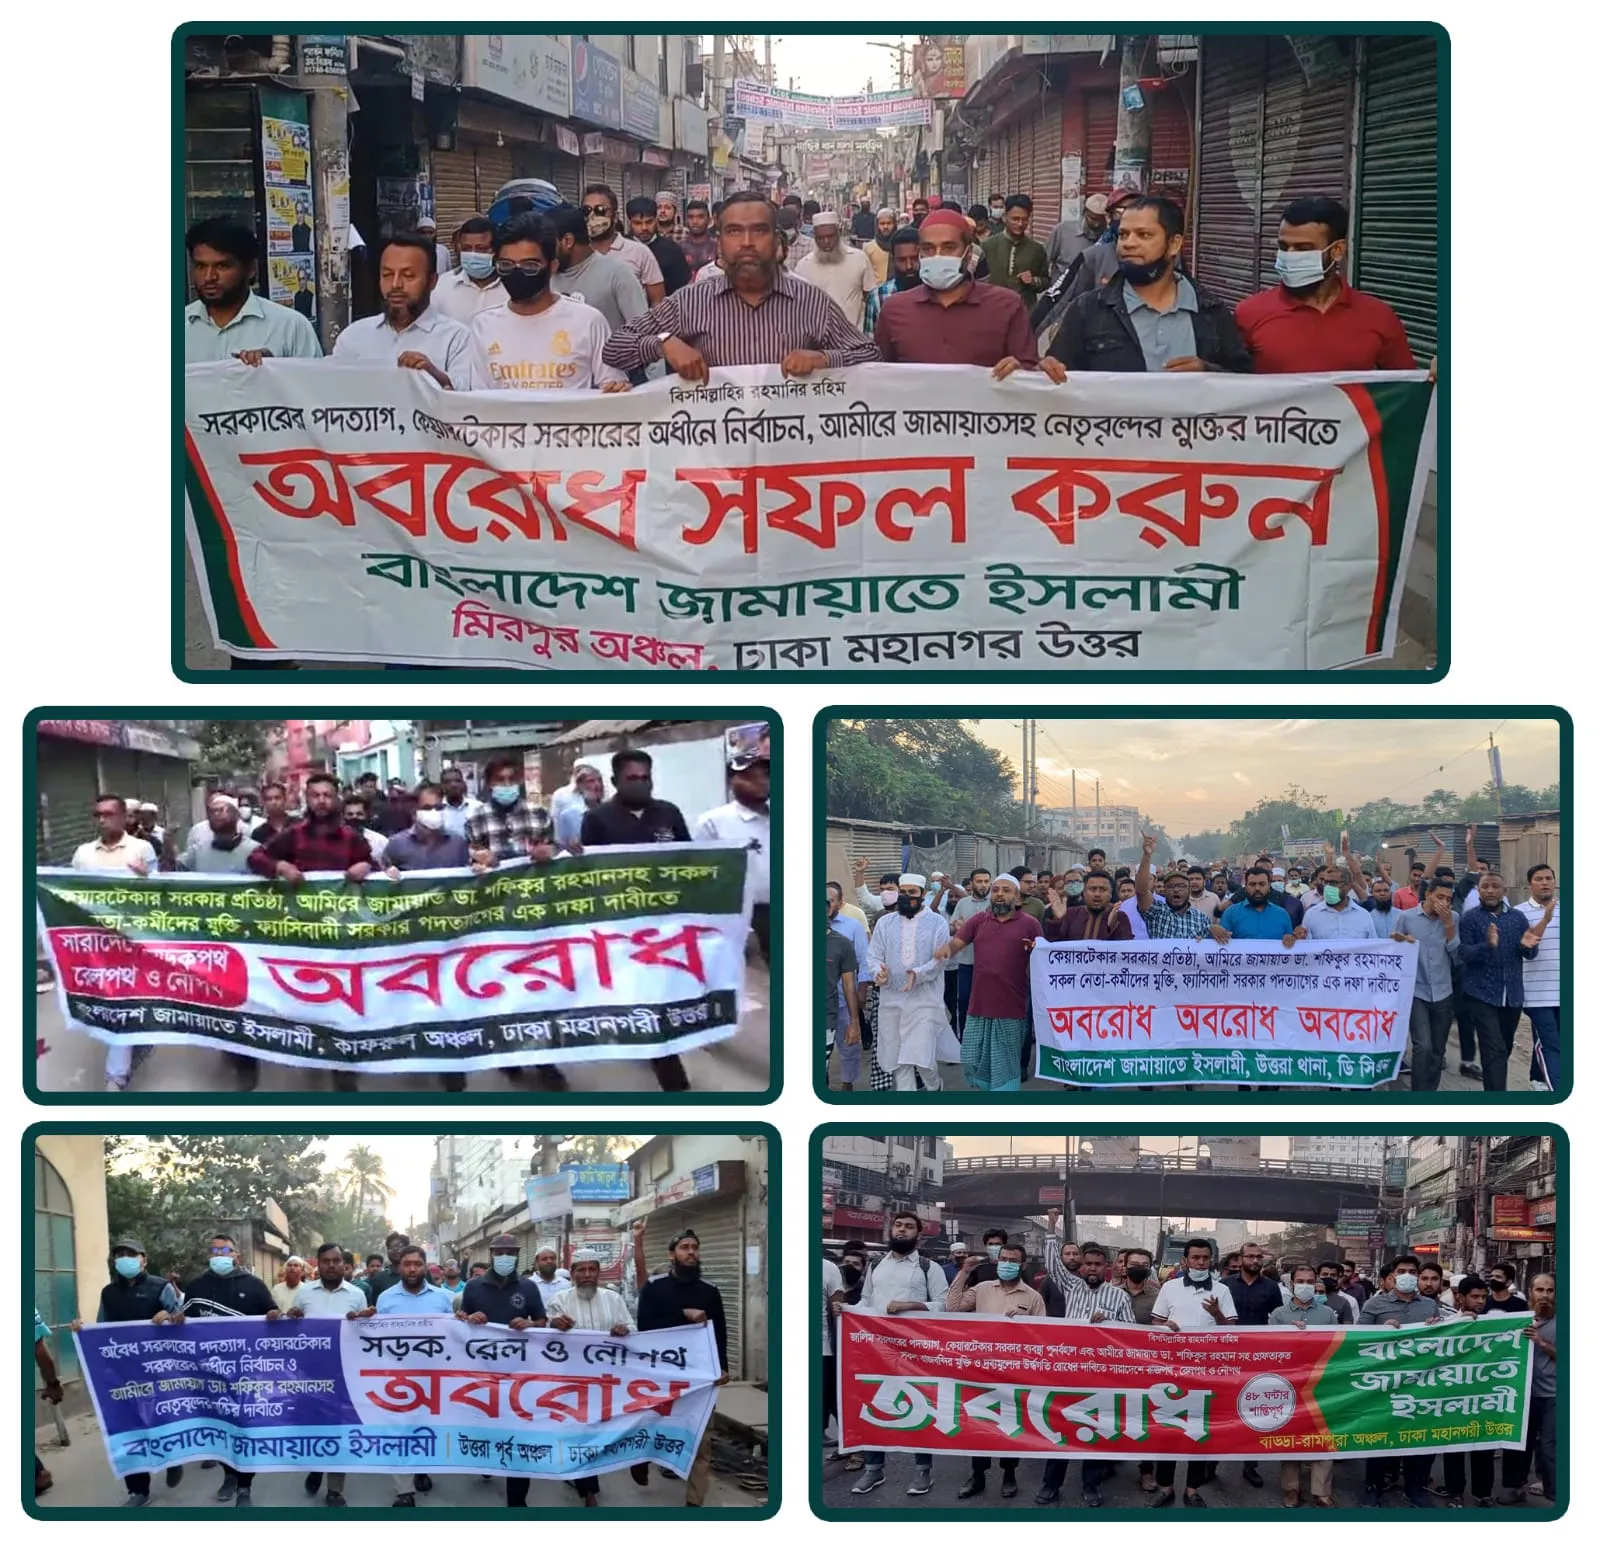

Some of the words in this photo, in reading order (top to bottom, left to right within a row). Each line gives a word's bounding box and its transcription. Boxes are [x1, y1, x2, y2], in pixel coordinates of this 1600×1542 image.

[489, 361, 577, 381] Emirates
[670, 382, 744, 404] বিসমিল্লাহির
[750, 380, 807, 400] রহমানির
[812, 377, 847, 397] রহিম
[199, 406, 306, 435] সরকারের
[311, 407, 405, 435] পদত্যাগ,
[533, 421, 642, 449] সরকারের
[648, 409, 717, 447] অধীনে
[722, 406, 814, 446] নির্বাচন,
[818, 400, 897, 439] আমীরে
[903, 409, 1037, 437] জামায়াতসহ
[1044, 412, 1162, 447] নেতৃবৃন্দের
[1171, 412, 1248, 449] মুক্তির
[1255, 406, 1341, 446] দাবিতে
[238, 449, 647, 552] অবরোধ
[675, 456, 975, 555] সফল
[1007, 457, 1343, 550] করুন
[361, 553, 639, 610] বাংলাদেশ
[657, 574, 965, 624] জামায়াতে
[984, 563, 1246, 614] ইসলামী
[452, 600, 580, 659] মিরপুর
[733, 637, 831, 670] ঢাকা
[843, 631, 1023, 666] মহানগর
[1036, 621, 1143, 659] উত্তর
[168, 891, 226, 908] সরকার
[231, 887, 289, 914] প্রতিষ্ঠা,
[296, 890, 359, 913] আমিরে
[367, 887, 445, 914] জামায়াত
[485, 877, 546, 899] শফিকুর
[551, 867, 652, 890] রহমানসহ
[658, 866, 719, 881] সকল
[90, 910, 202, 932] তা-কর্মীদের
[254, 916, 340, 940] ফ্যাসিবাদী
[347, 919, 410, 938] সরকার
[512, 903, 546, 921] এক
[555, 896, 595, 916] দফা
[603, 886, 681, 911] দাবীতে
[257, 925, 724, 1016] অবরোধ
[1048, 947, 1118, 965] কেয়ারটেকার
[1121, 950, 1159, 966] সরকার
[1162, 946, 1200, 969] প্রতিষ্ঠা,
[1205, 947, 1242, 966] আমিরে
[1246, 953, 1291, 967] জামায়াত
[1314, 948, 1350, 970] শফিকুর
[1354, 952, 1404, 971] রহমানসহ
[145, 970, 161, 987] ও
[1049, 973, 1076, 989] সকল
[1080, 967, 1150, 989] নেতা-কর্মীদের
[1153, 968, 1178, 992] মুক্তি,
[1182, 969, 1230, 990] ফ্যাসিবাদী
[1233, 974, 1267, 988] সরকার
[1270, 974, 1319, 990] পদত্যাগের
[1323, 976, 1341, 990] এক
[1344, 976, 1364, 992] দফা
[1367, 972, 1401, 993] দাবীতে
[152, 1006, 237, 1034] জামায়াতে
[500, 1019, 551, 1042] ঢাকা
[556, 1008, 661, 1036] মহানগরী
[1047, 1000, 1157, 1041] অবরোধ
[1174, 1000, 1279, 1041] অবরোধ
[1296, 1005, 1399, 1044] অবরোধ
[1051, 1054, 1116, 1077] বাংলাদেশ
[1119, 1055, 1188, 1077] জামায়াতে
[1192, 1050, 1251, 1079] ইসলামী,
[1255, 1052, 1294, 1076] উত্তরা
[1297, 1057, 1333, 1080] থানা,
[99, 1338, 139, 1359] অবৈধ
[143, 1340, 196, 1355] সরকারের
[199, 1338, 252, 1355] পদত্যাগ,
[255, 1333, 332, 1352] কেয়ারটেকার
[466, 1338, 529, 1361] রেল
[541, 1340, 569, 1362] ও
[583, 1341, 628, 1366] নৌ
[633, 1347, 687, 1370] পথ
[995, 1343, 1021, 1353] সরকার
[1209, 1352, 1236, 1362] রহমান
[1358, 1328, 1525, 1360] বাংলাদেশ
[200, 1355, 237, 1375] ধীনে
[240, 1355, 284, 1373] নির্বাচন
[287, 1361, 297, 1372] ও
[1350, 1356, 1521, 1393] জামায়াতে
[109, 1381, 155, 1401] আমীরে
[207, 1380, 227, 1394] ডাঃ
[229, 1375, 274, 1399] শফিকুর
[277, 1379, 335, 1395] রহমানসহ
[359, 1368, 690, 1424] অবরোধ
[1245, 1391, 1260, 1401] ৪৮
[1390, 1384, 1517, 1420] ইসলামী
[243, 1400, 283, 1418] দাবীতে
[854, 1373, 1215, 1447] অবরোধ
[230, 1434, 341, 1460] জামায়াতে
[348, 1427, 437, 1459] ইসলামী
[458, 1432, 490, 1459] উত্তরা
[495, 1435, 513, 1468] পূর্ব
[568, 1444, 599, 1465] ঢাকা
[654, 1430, 686, 1456] উত্তর
[1259, 1432, 1348, 1452] বাড্ডা-রামপুরা
[1353, 1431, 1394, 1447] অঞ্চল,
[1399, 1428, 1427, 1444] ঢাকা
[1431, 1420, 1481, 1441] মহানগরী
[1485, 1419, 1515, 1437] উত্তর
